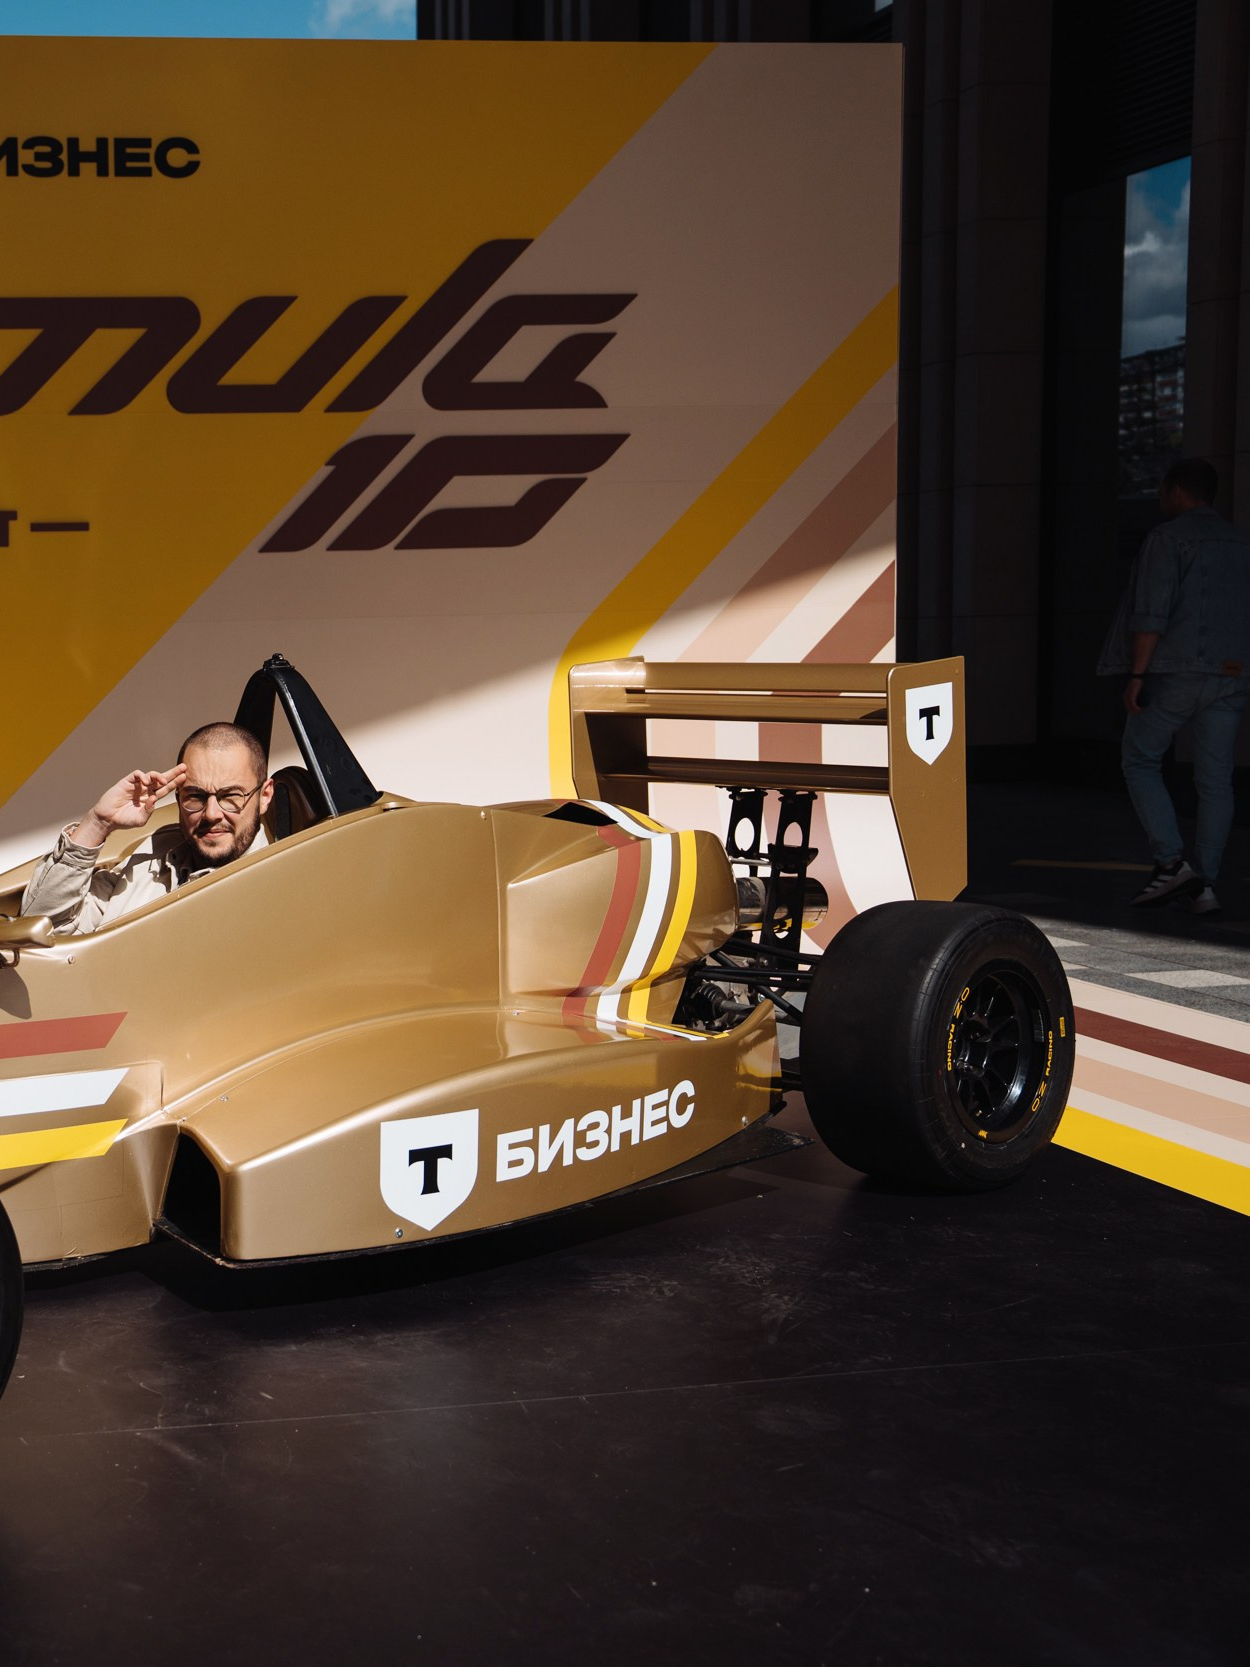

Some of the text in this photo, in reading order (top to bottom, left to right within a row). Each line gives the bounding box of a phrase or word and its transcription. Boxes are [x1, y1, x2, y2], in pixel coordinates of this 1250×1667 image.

[258, 433, 631, 553] 10
[918, 705, 940, 741] Т
[947, 1024, 955, 1071] RACING
[1045, 1031, 1053, 1076] RACING
[408, 1079, 696, 1196] Т БИЗНЕС
